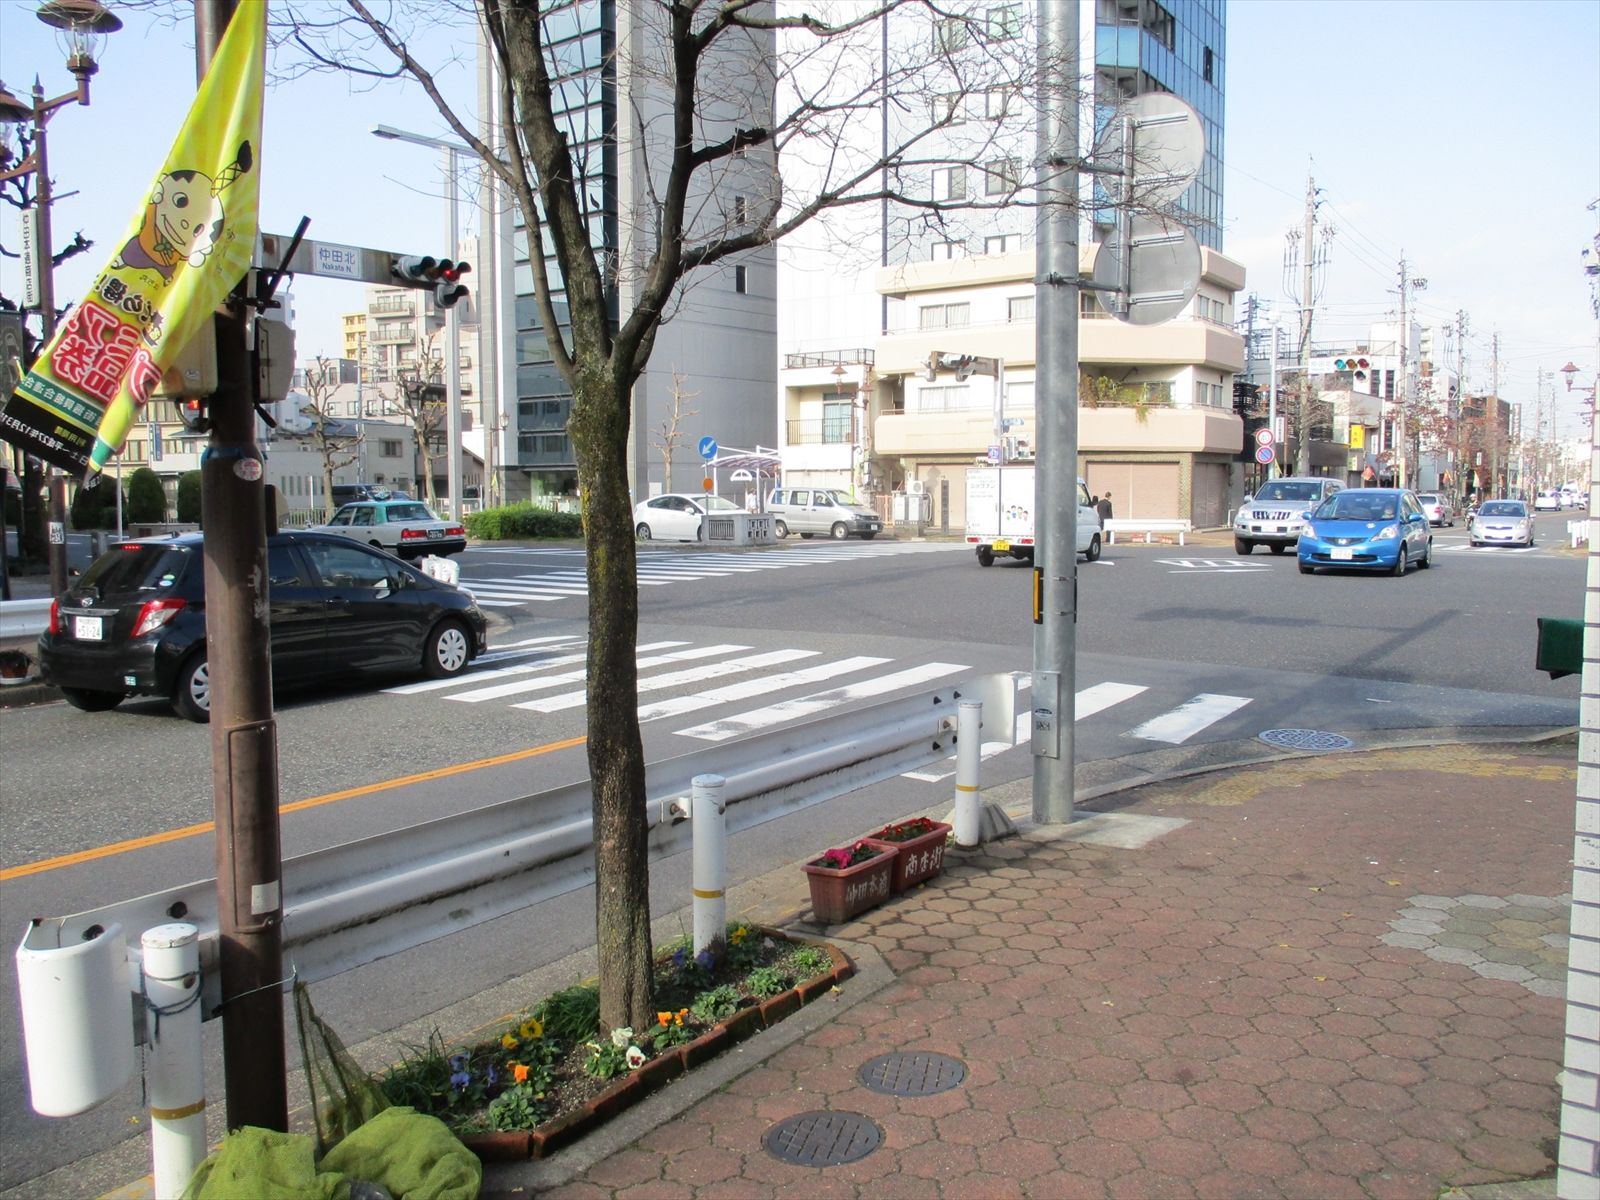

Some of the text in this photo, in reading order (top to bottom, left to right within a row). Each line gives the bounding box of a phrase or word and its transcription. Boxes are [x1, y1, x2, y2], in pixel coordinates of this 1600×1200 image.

[319, 247, 355, 265] 仲田北
[322, 262, 344, 272] Nakata
